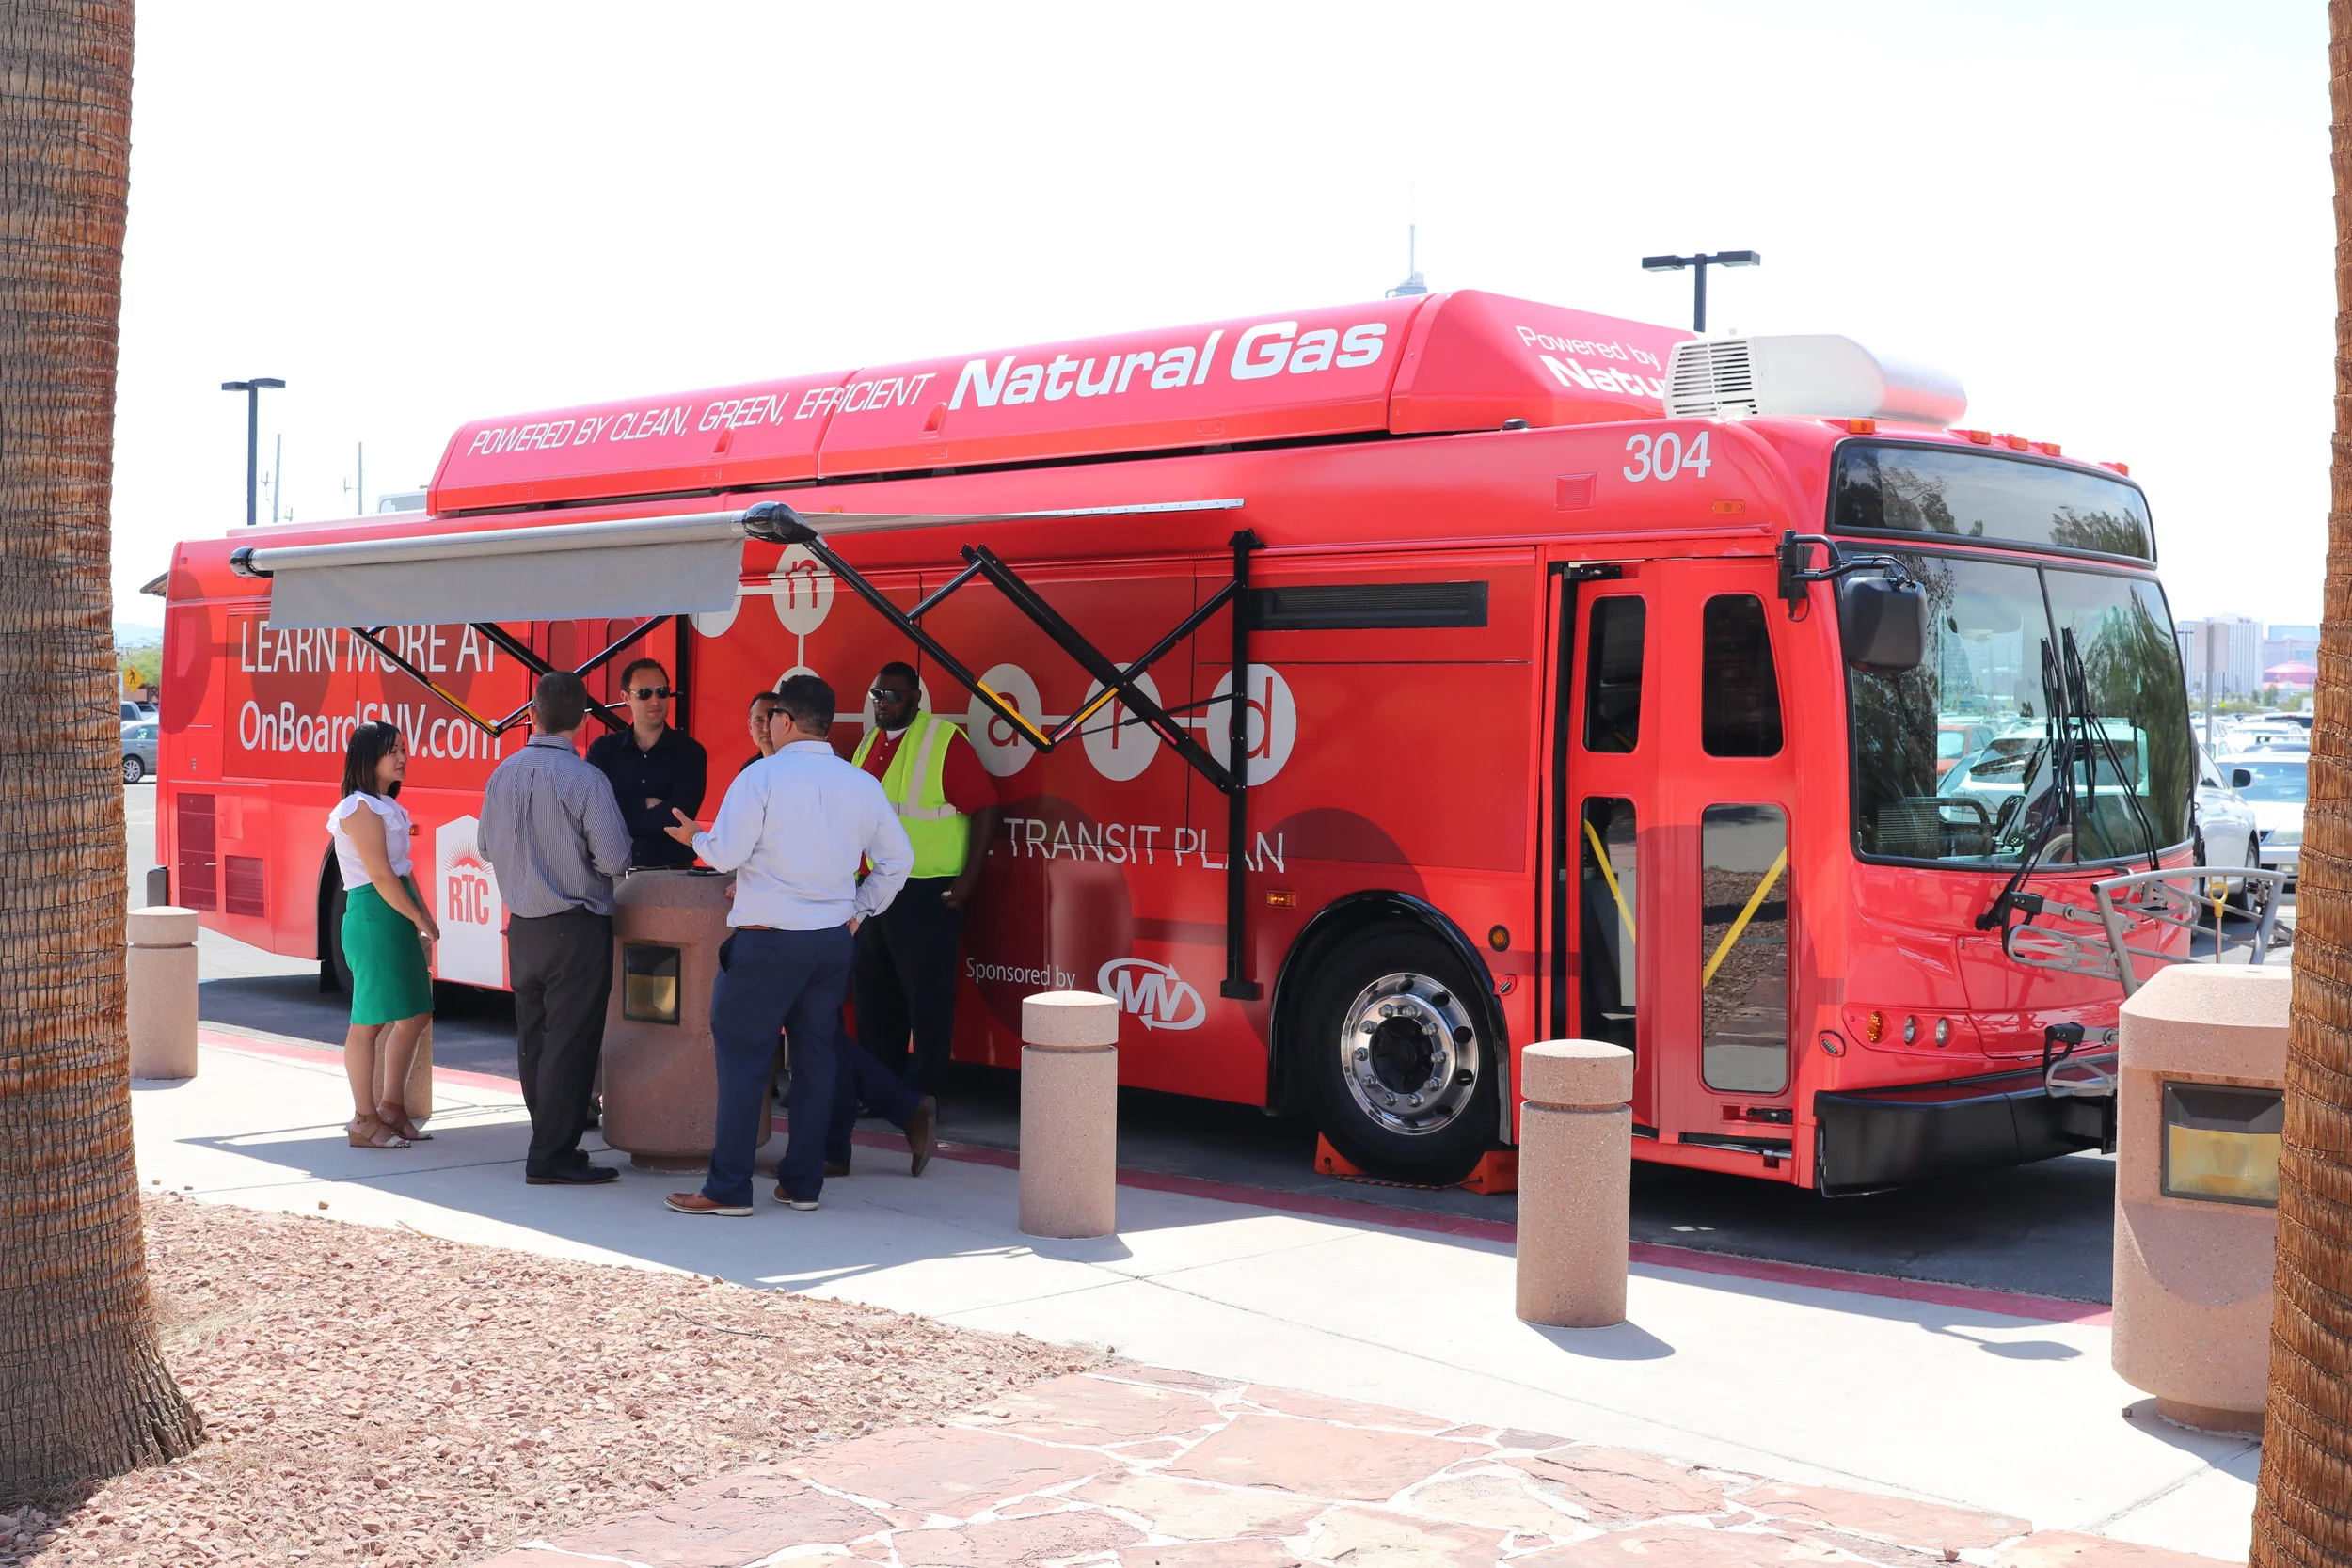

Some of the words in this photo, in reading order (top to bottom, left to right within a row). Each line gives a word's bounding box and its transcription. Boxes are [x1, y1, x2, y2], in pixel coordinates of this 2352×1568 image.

[1515, 325, 1628, 362] Powered
[1626, 343, 1662, 372] by
[467, 420, 576, 457] POWERED
[573, 415, 615, 446] BY
[609, 405, 693, 442] CLEAN,
[698, 392, 790, 432] GREEN,
[793, 372, 937, 420] EFFICIENT
[948, 329, 1225, 411] Natural
[1230, 321, 1387, 381] Gas
[1538, 354, 1666, 400] Natu
[1623, 430, 1712, 483] 304
[241, 621, 337, 673] LEARN
[347, 623, 447, 673] MORE
[1003, 817, 1161, 865] TRANSIT
[448, 873, 490, 926] RTC
[966, 957, 1051, 987] Sponsored
[1055, 965, 1076, 991] by
